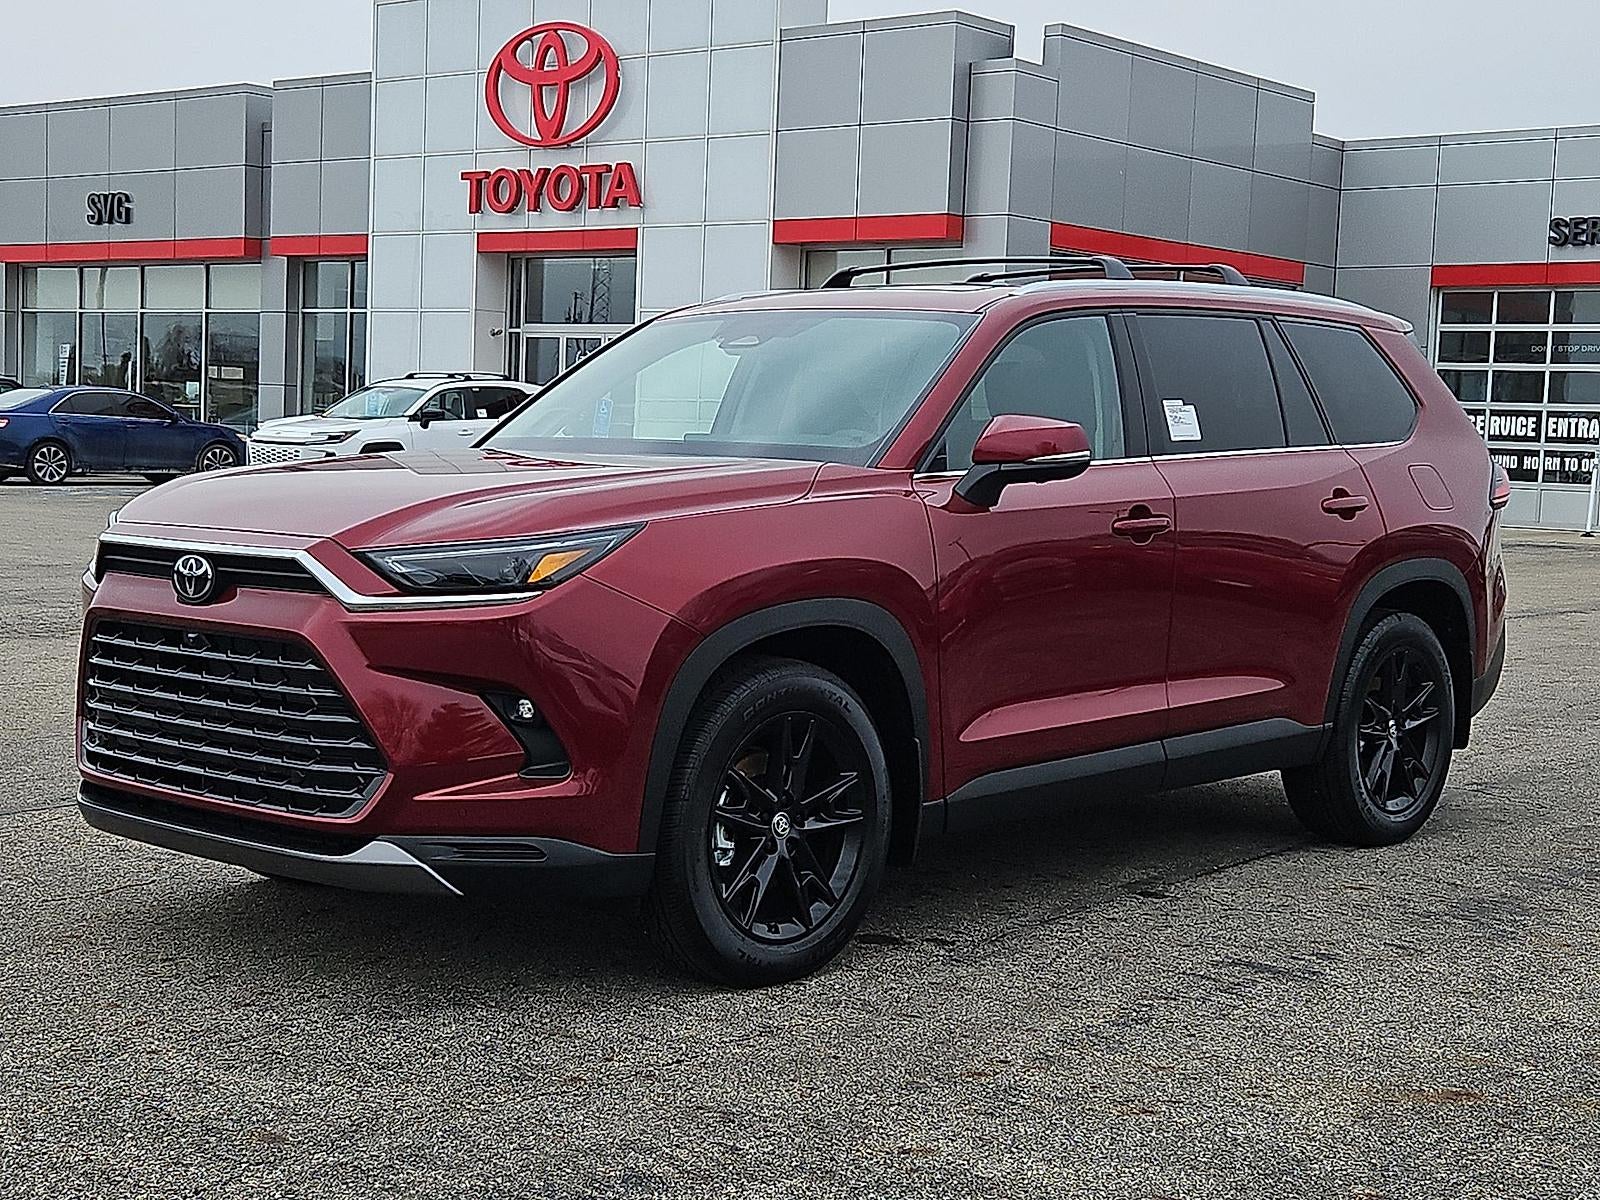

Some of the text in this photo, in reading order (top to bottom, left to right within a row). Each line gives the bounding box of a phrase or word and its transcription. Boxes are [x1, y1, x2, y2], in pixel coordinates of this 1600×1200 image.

[460, 162, 643, 214] TOYOTA
[86, 192, 133, 225] SVG
[1549, 217, 1600, 246] SER
[1547, 417, 1600, 438] ENTRA
[1523, 455, 1560, 471] HORN
[1563, 457, 1579, 472] TO
